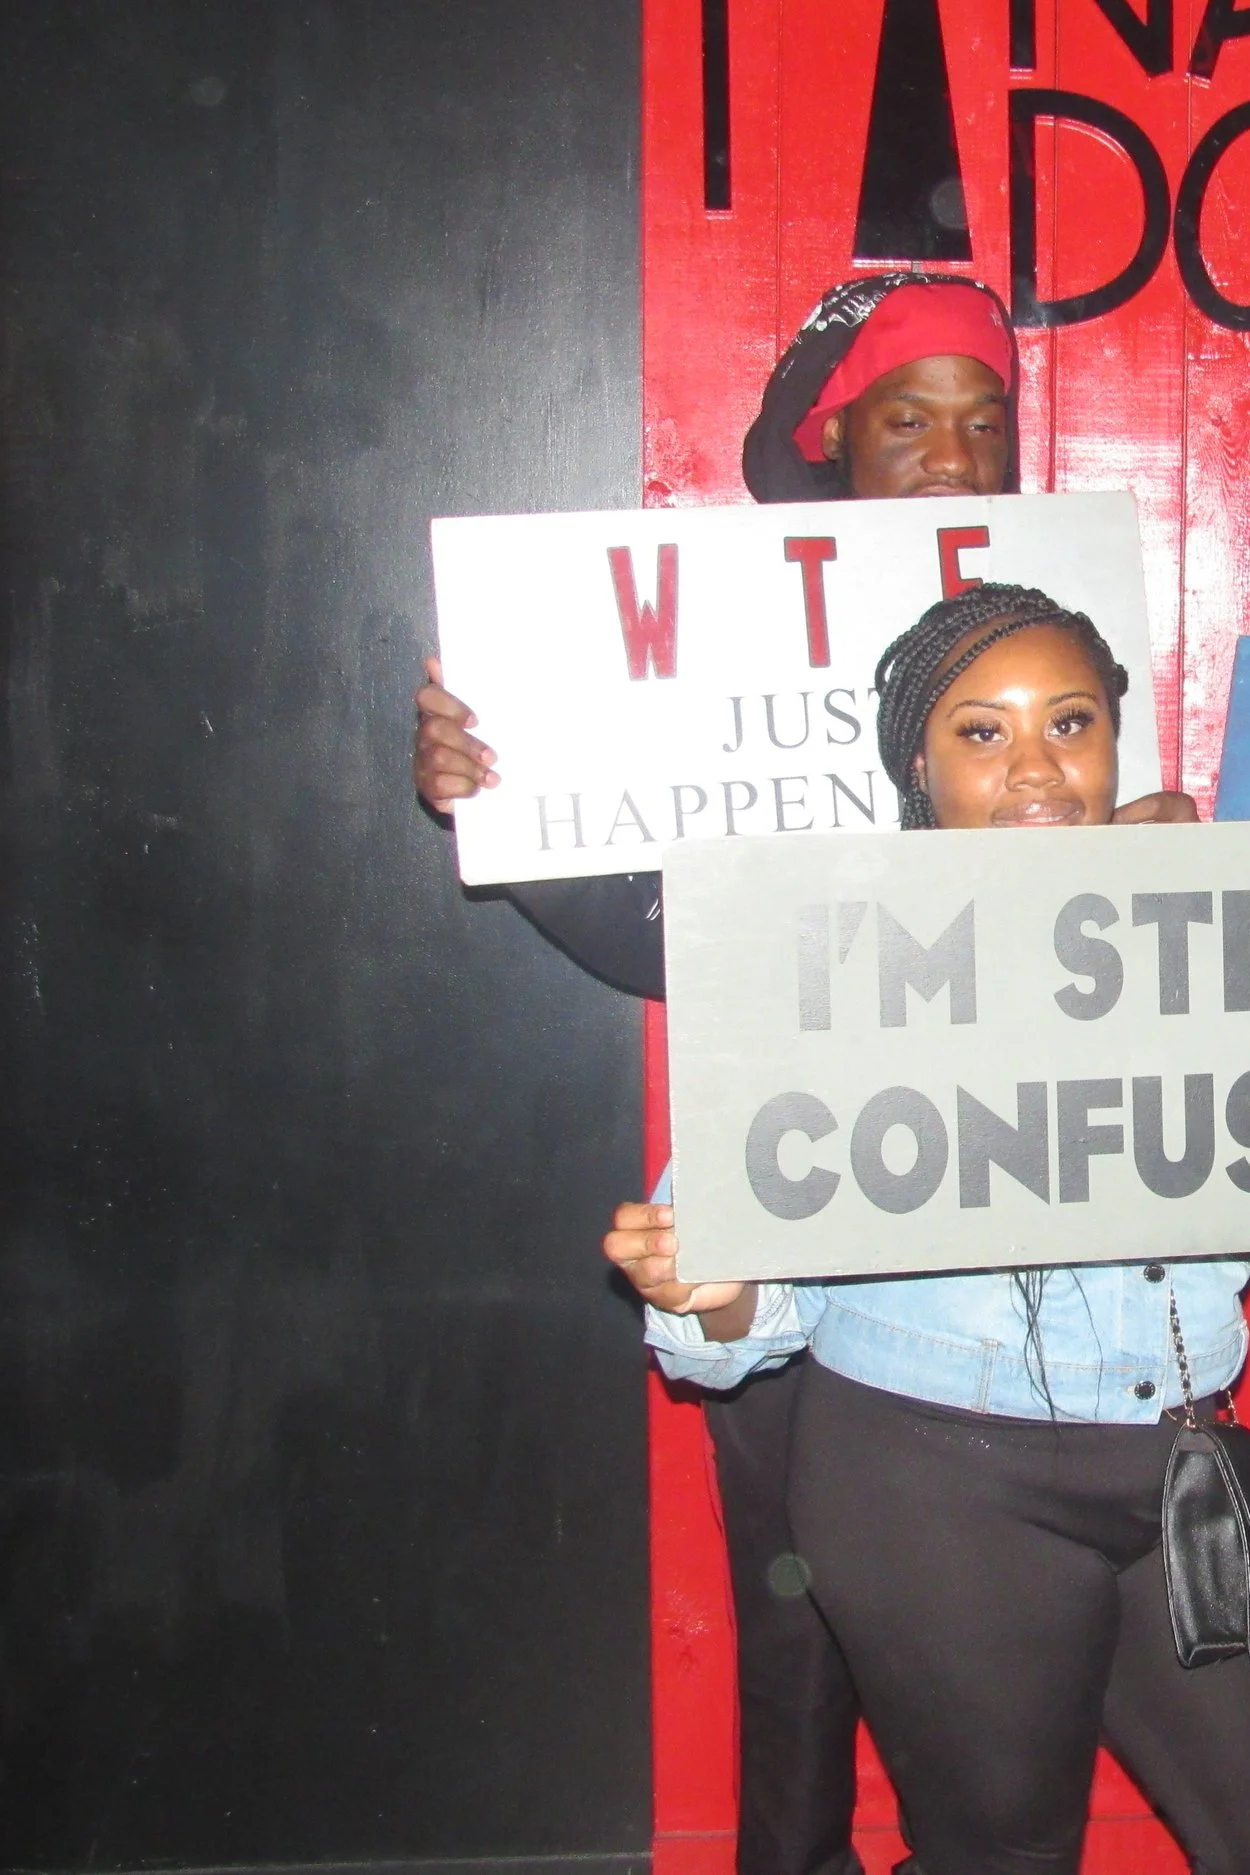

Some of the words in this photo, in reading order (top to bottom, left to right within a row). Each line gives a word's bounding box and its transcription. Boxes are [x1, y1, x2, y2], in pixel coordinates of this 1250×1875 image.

[723, 687, 878, 753] JUS
[536, 770, 904, 851] HAPPEN
[799, 898, 977, 1032] I'M
